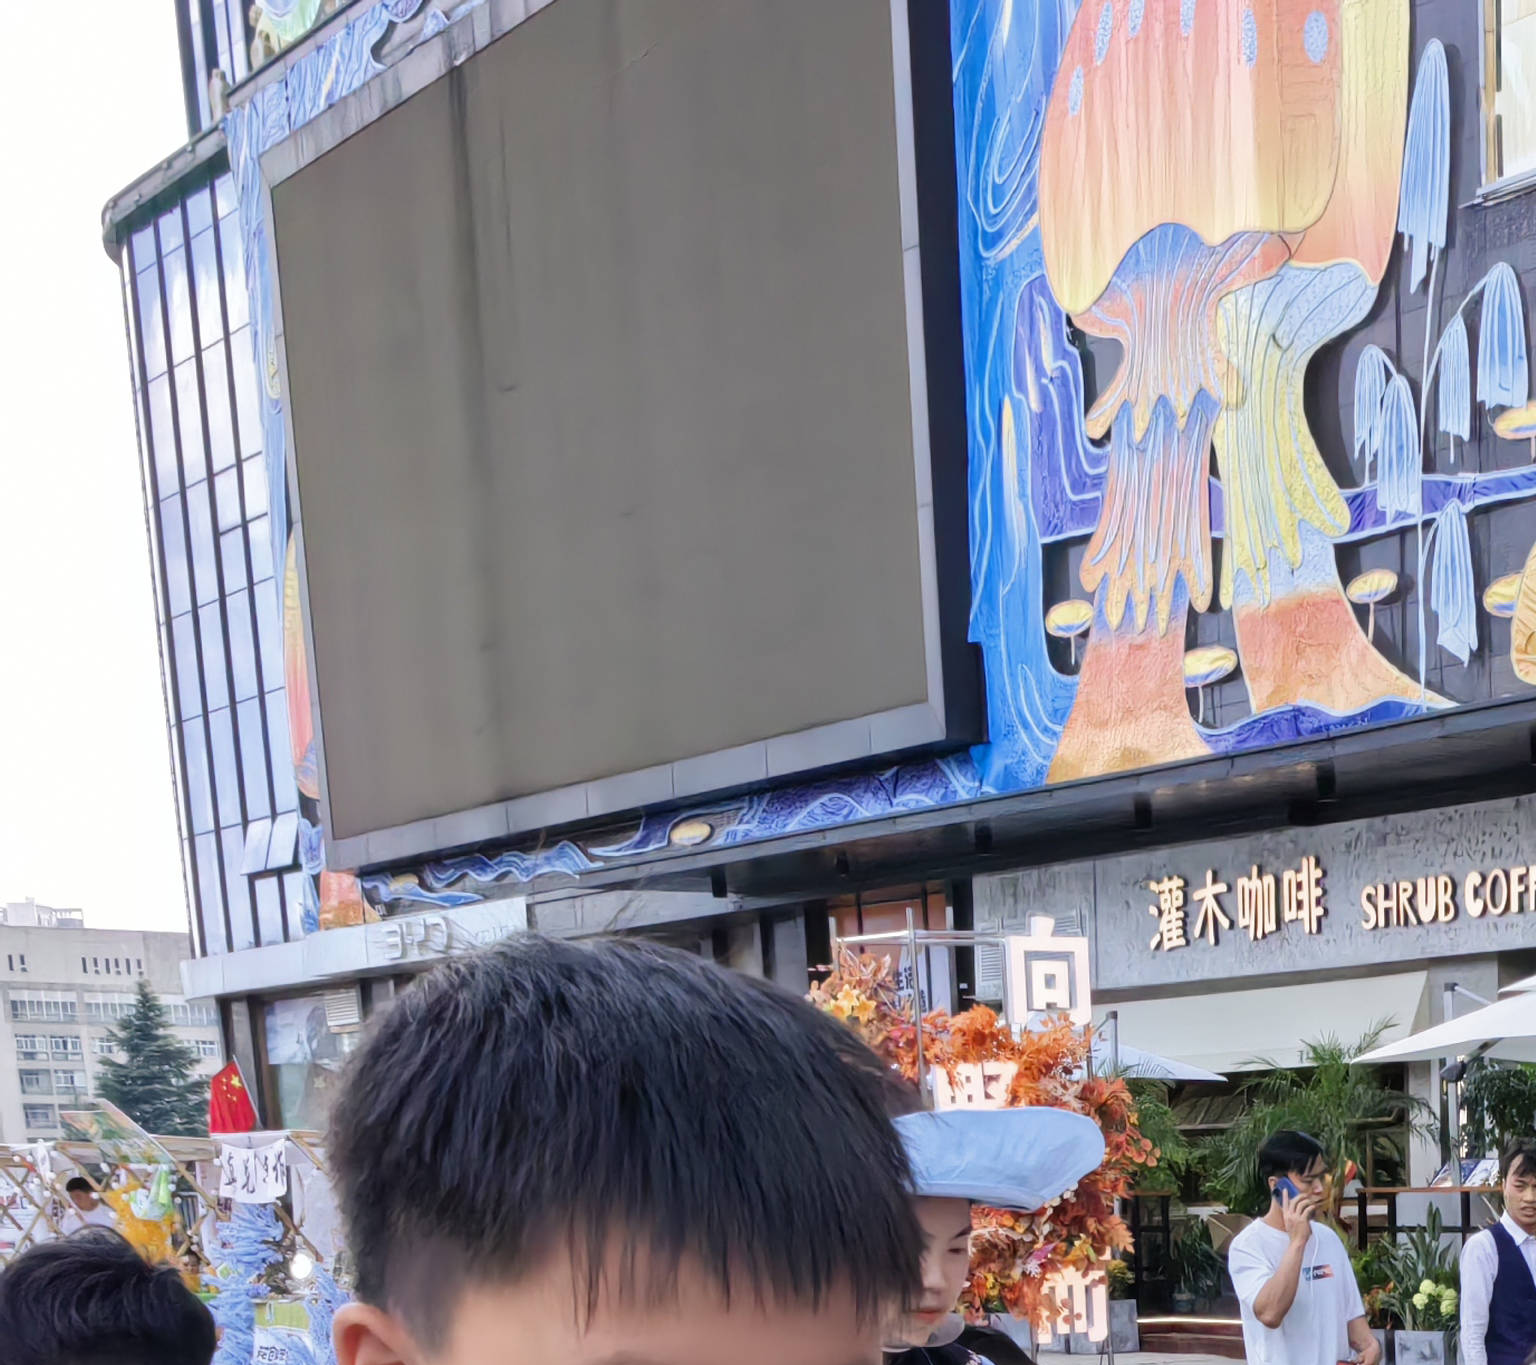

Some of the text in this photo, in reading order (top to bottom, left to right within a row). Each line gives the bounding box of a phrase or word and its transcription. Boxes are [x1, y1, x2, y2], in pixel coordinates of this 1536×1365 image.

[1149, 855, 1326, 951] 灌木咖啡
[1361, 874, 1457, 930] SHRUB
[1006, 913, 1091, 1026] 向
